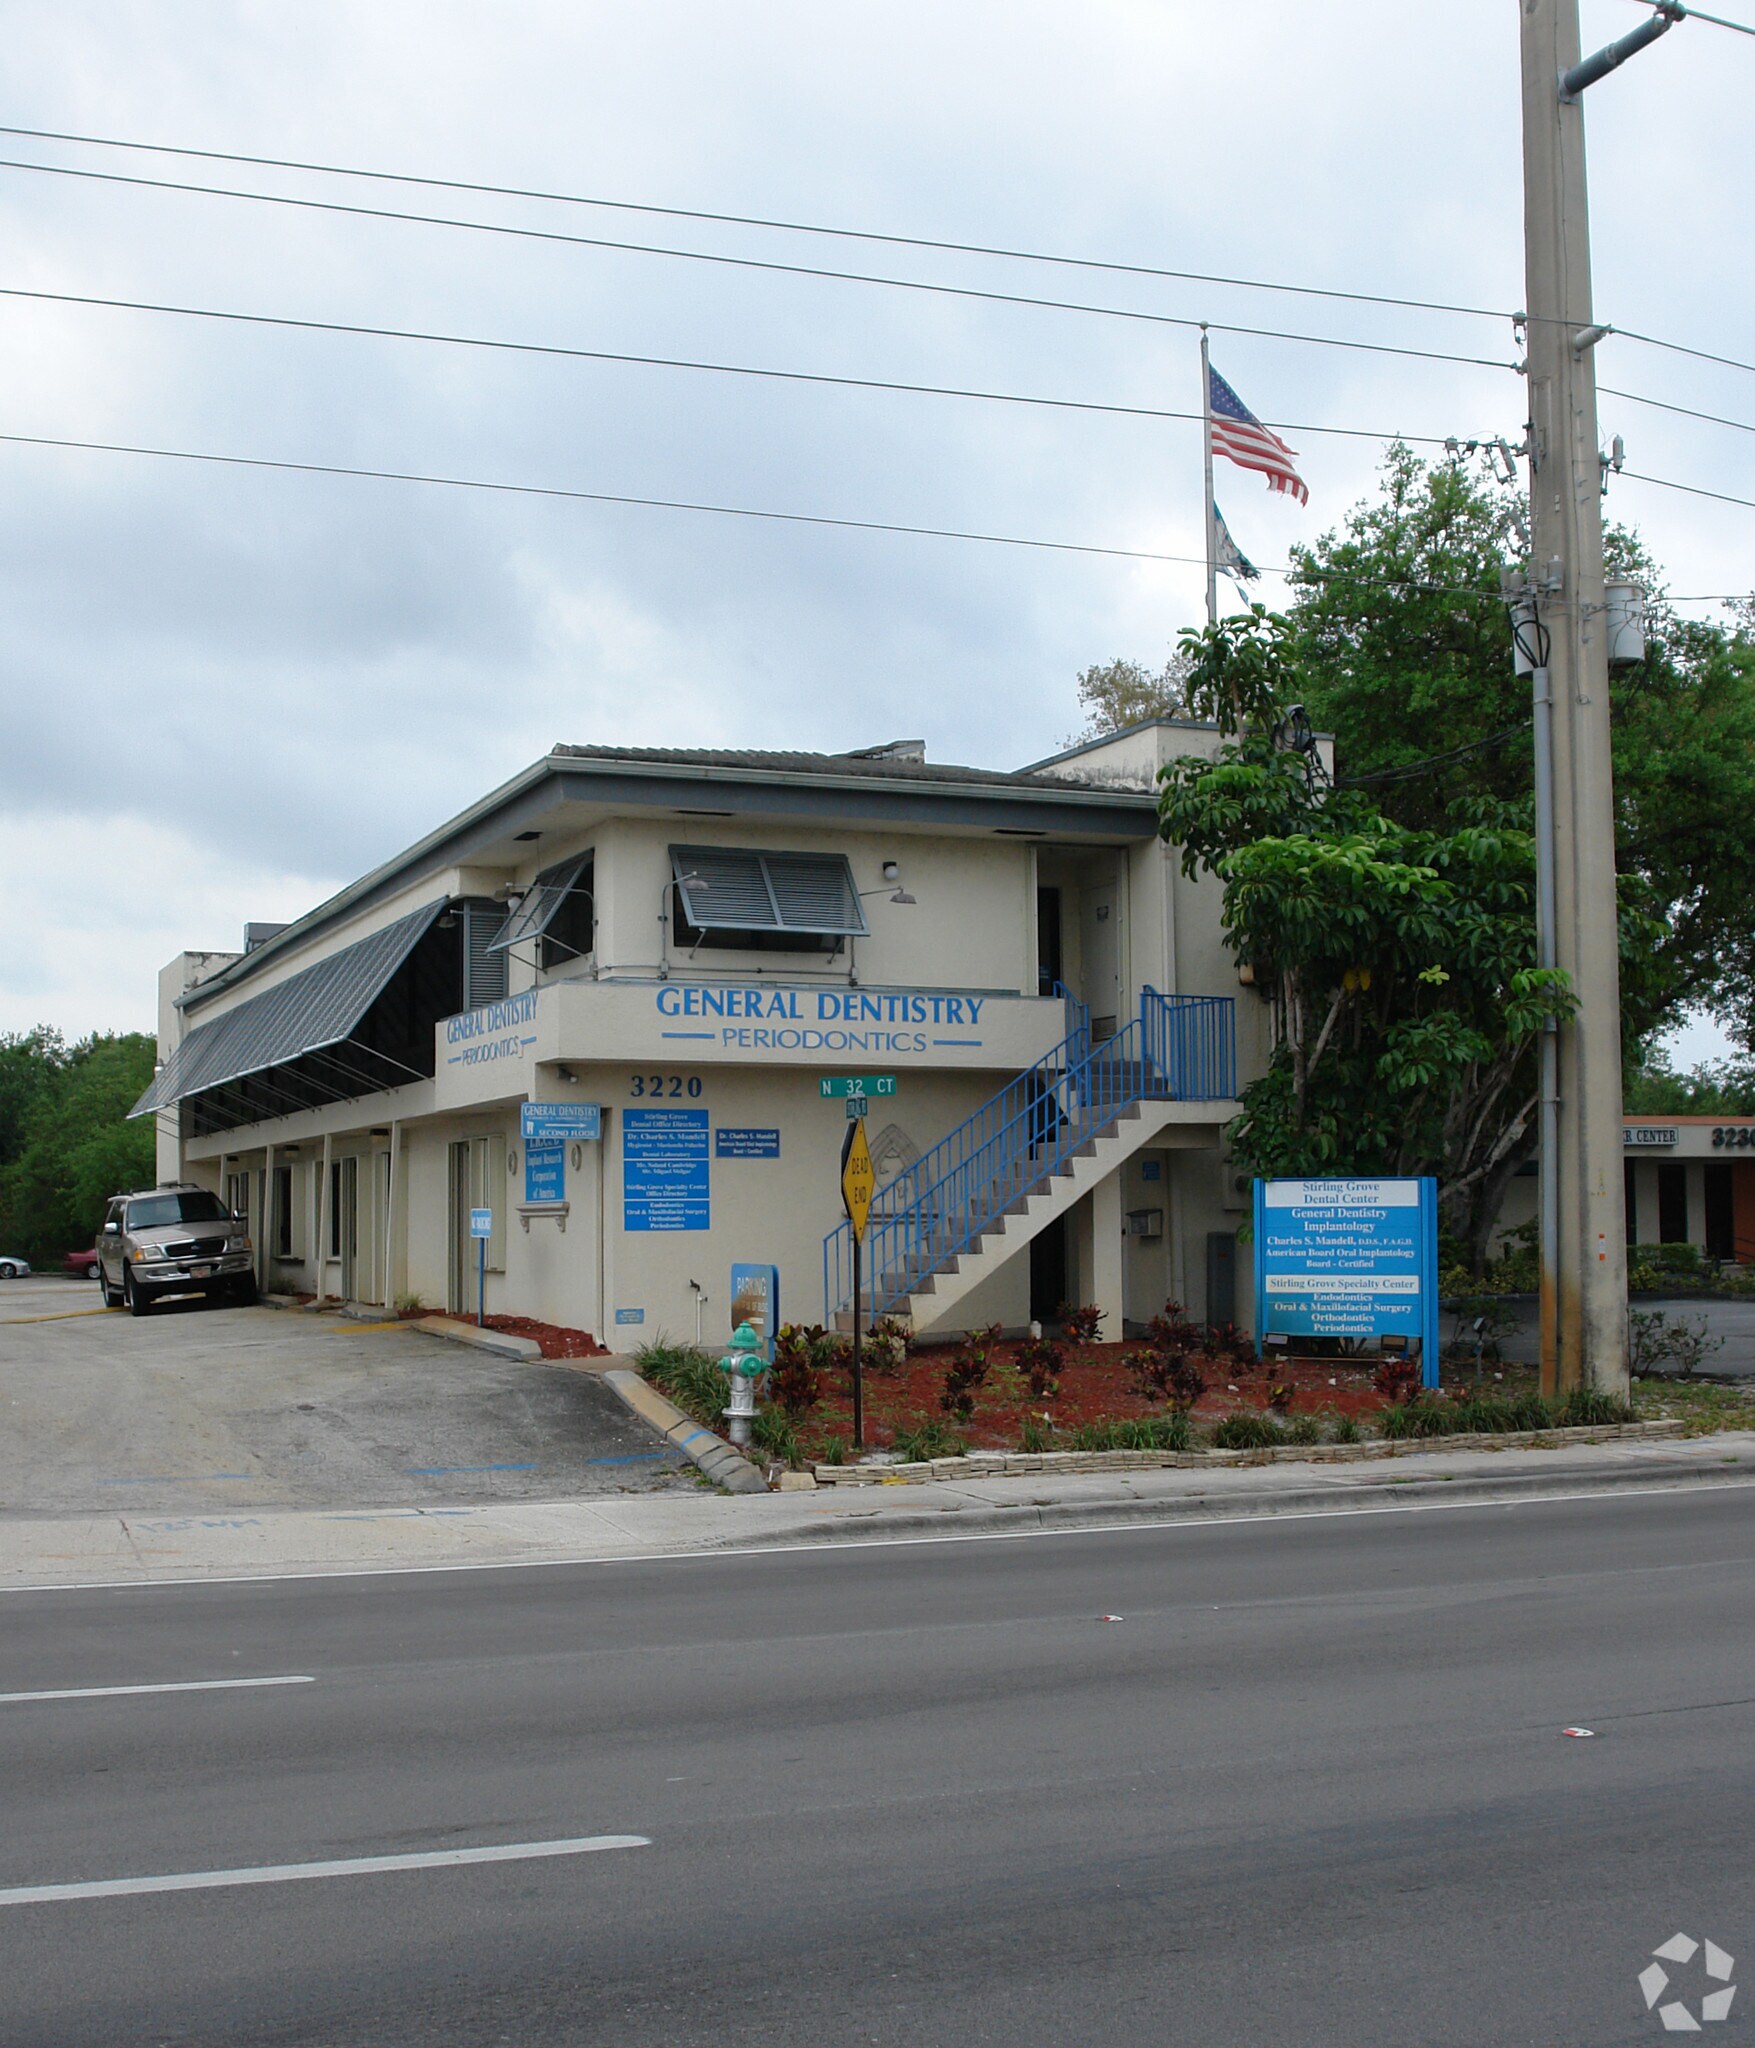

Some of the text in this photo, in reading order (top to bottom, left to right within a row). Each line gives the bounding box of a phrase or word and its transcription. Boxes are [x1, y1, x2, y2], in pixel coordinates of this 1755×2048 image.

[656, 987, 984, 1024] GENERAL DENTISTRY
[447, 992, 538, 1044] GENERAL DENTISTRY
[722, 1027, 927, 1052] PERIODONTICS
[462, 1035, 519, 1066] PERIODONTICS
[630, 1075, 703, 1098] 3220
[822, 1078, 893, 1095] N 32 CT
[524, 1105, 597, 1117] GENERAL DENTISTRY
[669, 1113, 688, 1121] Grove
[672, 1121, 701, 1129] Directory
[1637, 1130, 1676, 1143] CENTER
[852, 1157, 868, 1175] DEAD
[1303, 1182, 1380, 1192] Stirling Grove
[855, 1186, 866, 1204] END
[1304, 1194, 1380, 1204] Dental Center
[1292, 1208, 1387, 1219] General Dentistry
[1304, 1221, 1375, 1233] Implantology
[1267, 1236, 1302, 1245] Charles
[1304, 1237, 1313, 1245] S.
[1315, 1236, 1356, 1246] Mandell,
[1266, 1249, 1415, 1258] American Board Oral Implantology
[1306, 1260, 1331, 1268] Board
[1338, 1259, 1375, 1268] Certified
[737, 1277, 767, 1296] PARKING
[1270, 1279, 1415, 1290] Stirling Grove Specialty Center
[1313, 1293, 1373, 1301] Endodontics
[1274, 1302, 1412, 1313] Oral & Maxillofacial Surgery
[1311, 1313, 1375, 1322] Orthodontics
[1313, 1323, 1373, 1332] Periodontics
